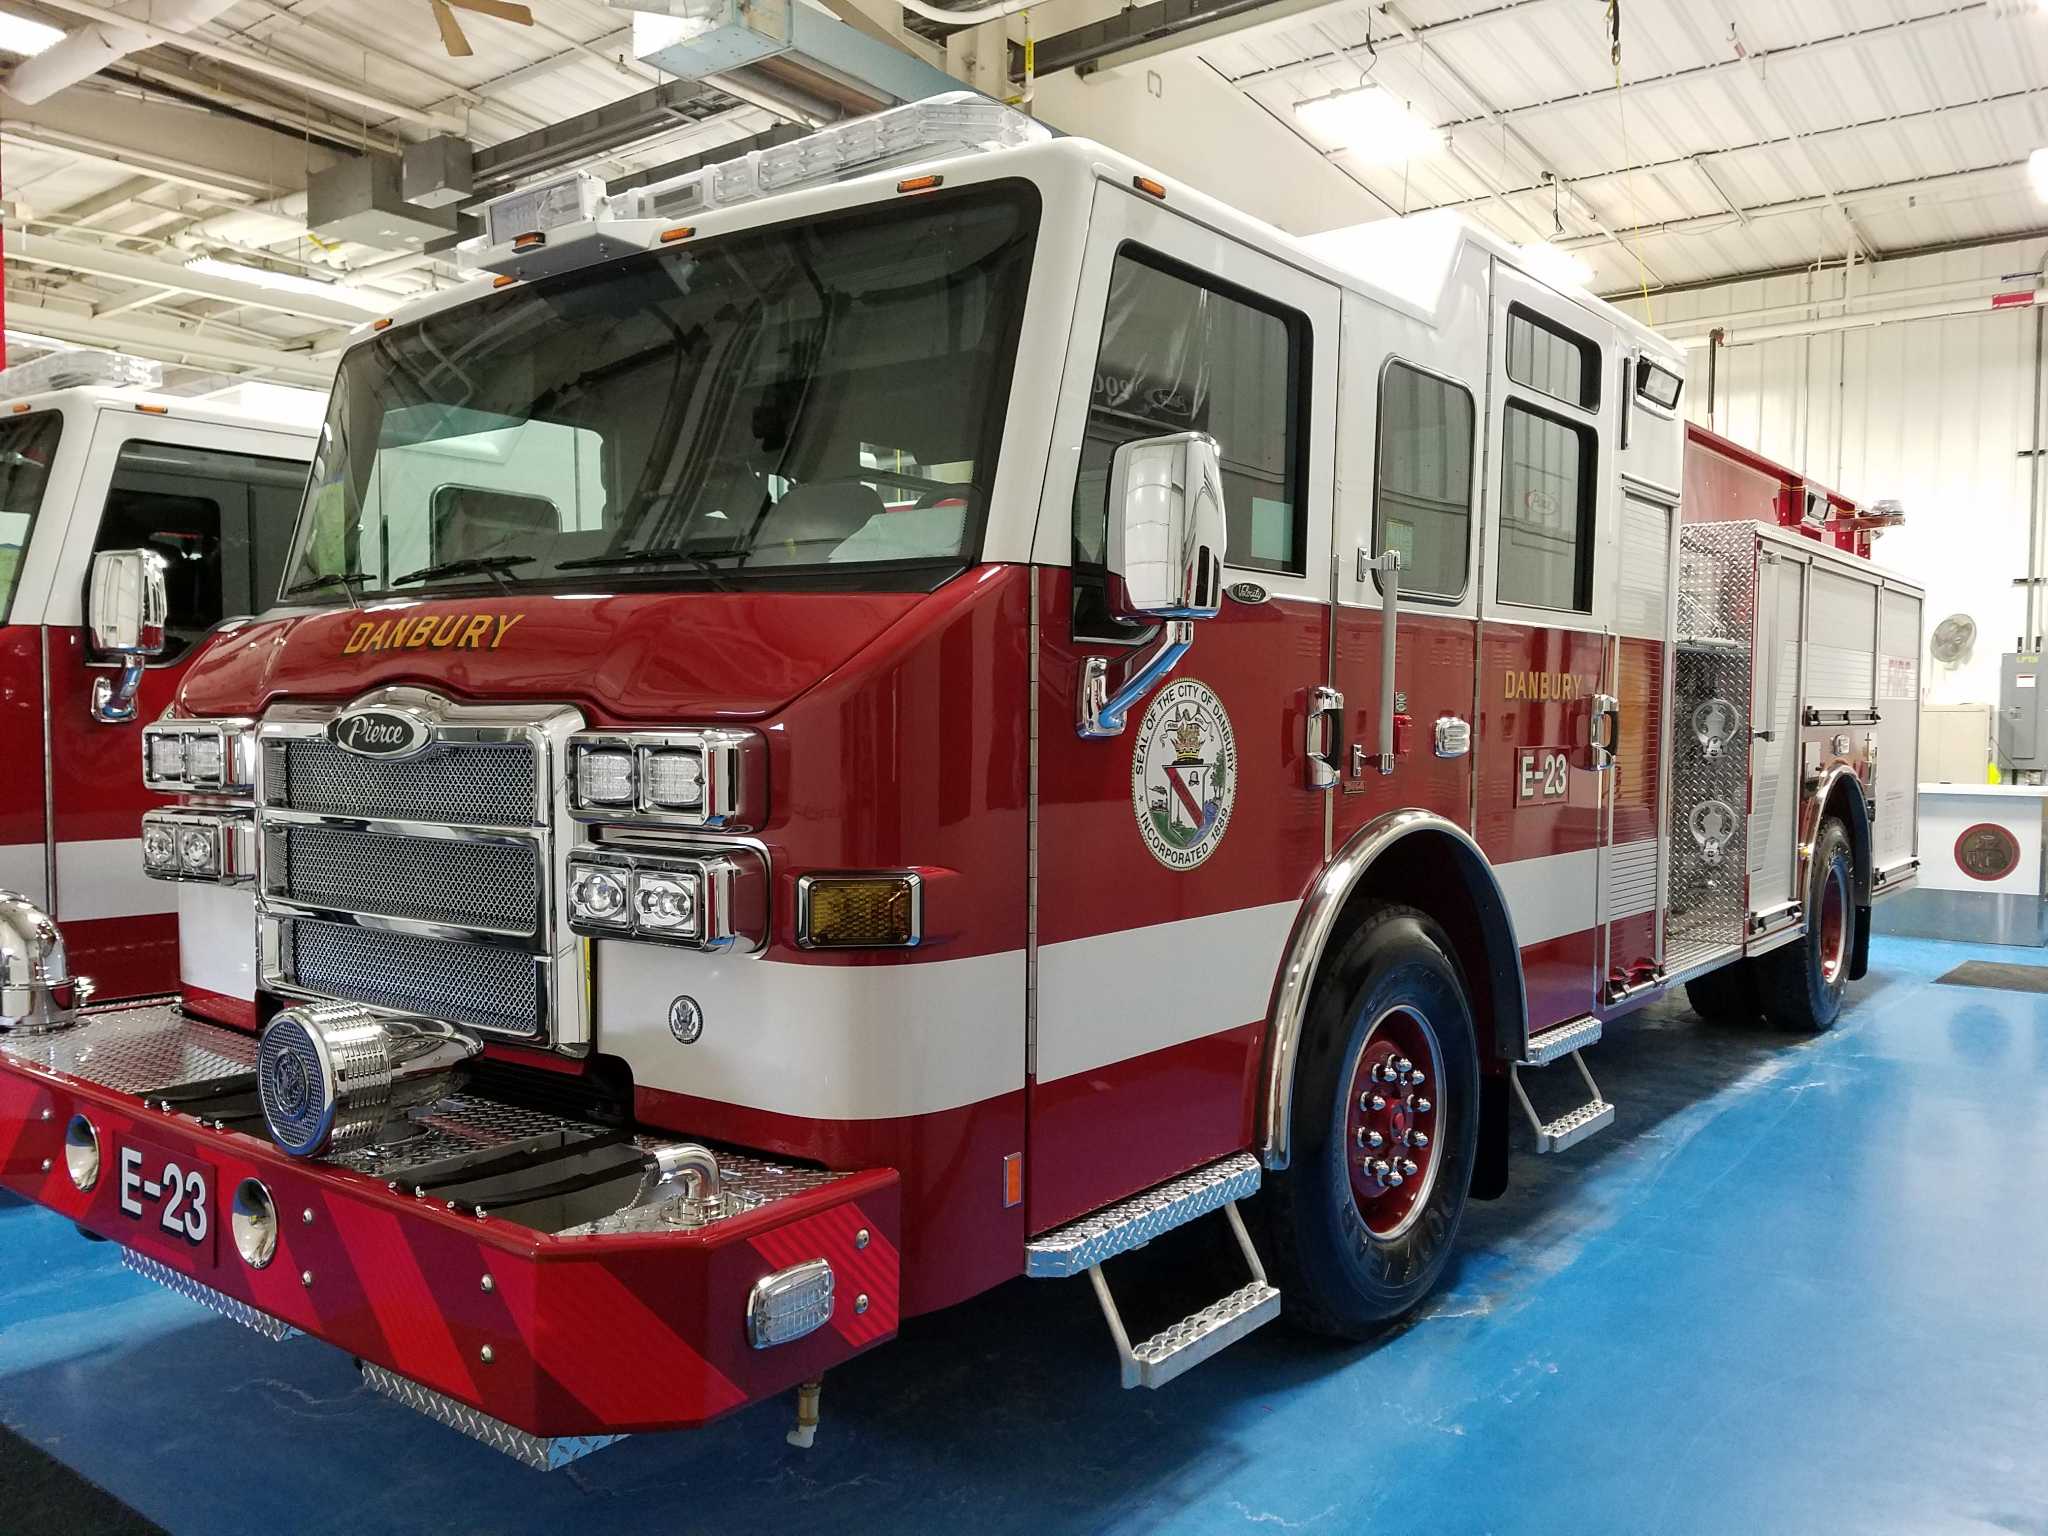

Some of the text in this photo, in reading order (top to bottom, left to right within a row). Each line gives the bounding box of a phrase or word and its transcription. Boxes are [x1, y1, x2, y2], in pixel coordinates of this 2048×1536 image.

[342, 614, 526, 655] DANBURY
[1504, 671, 1583, 701] DANBURY
[349, 715, 404, 746] Pierce
[1135, 735, 1150, 776] SEAL
[1145, 710, 1158, 731] OF
[1156, 689, 1176, 712] THE
[1177, 684, 1199, 698] CITY
[1201, 690, 1214, 706] OF
[1212, 703, 1235, 773] DANBURY
[1521, 754, 1568, 797] E-23
[1140, 807, 1228, 865] INCORPORATED 1889
[121, 1146, 208, 1243] E-23
